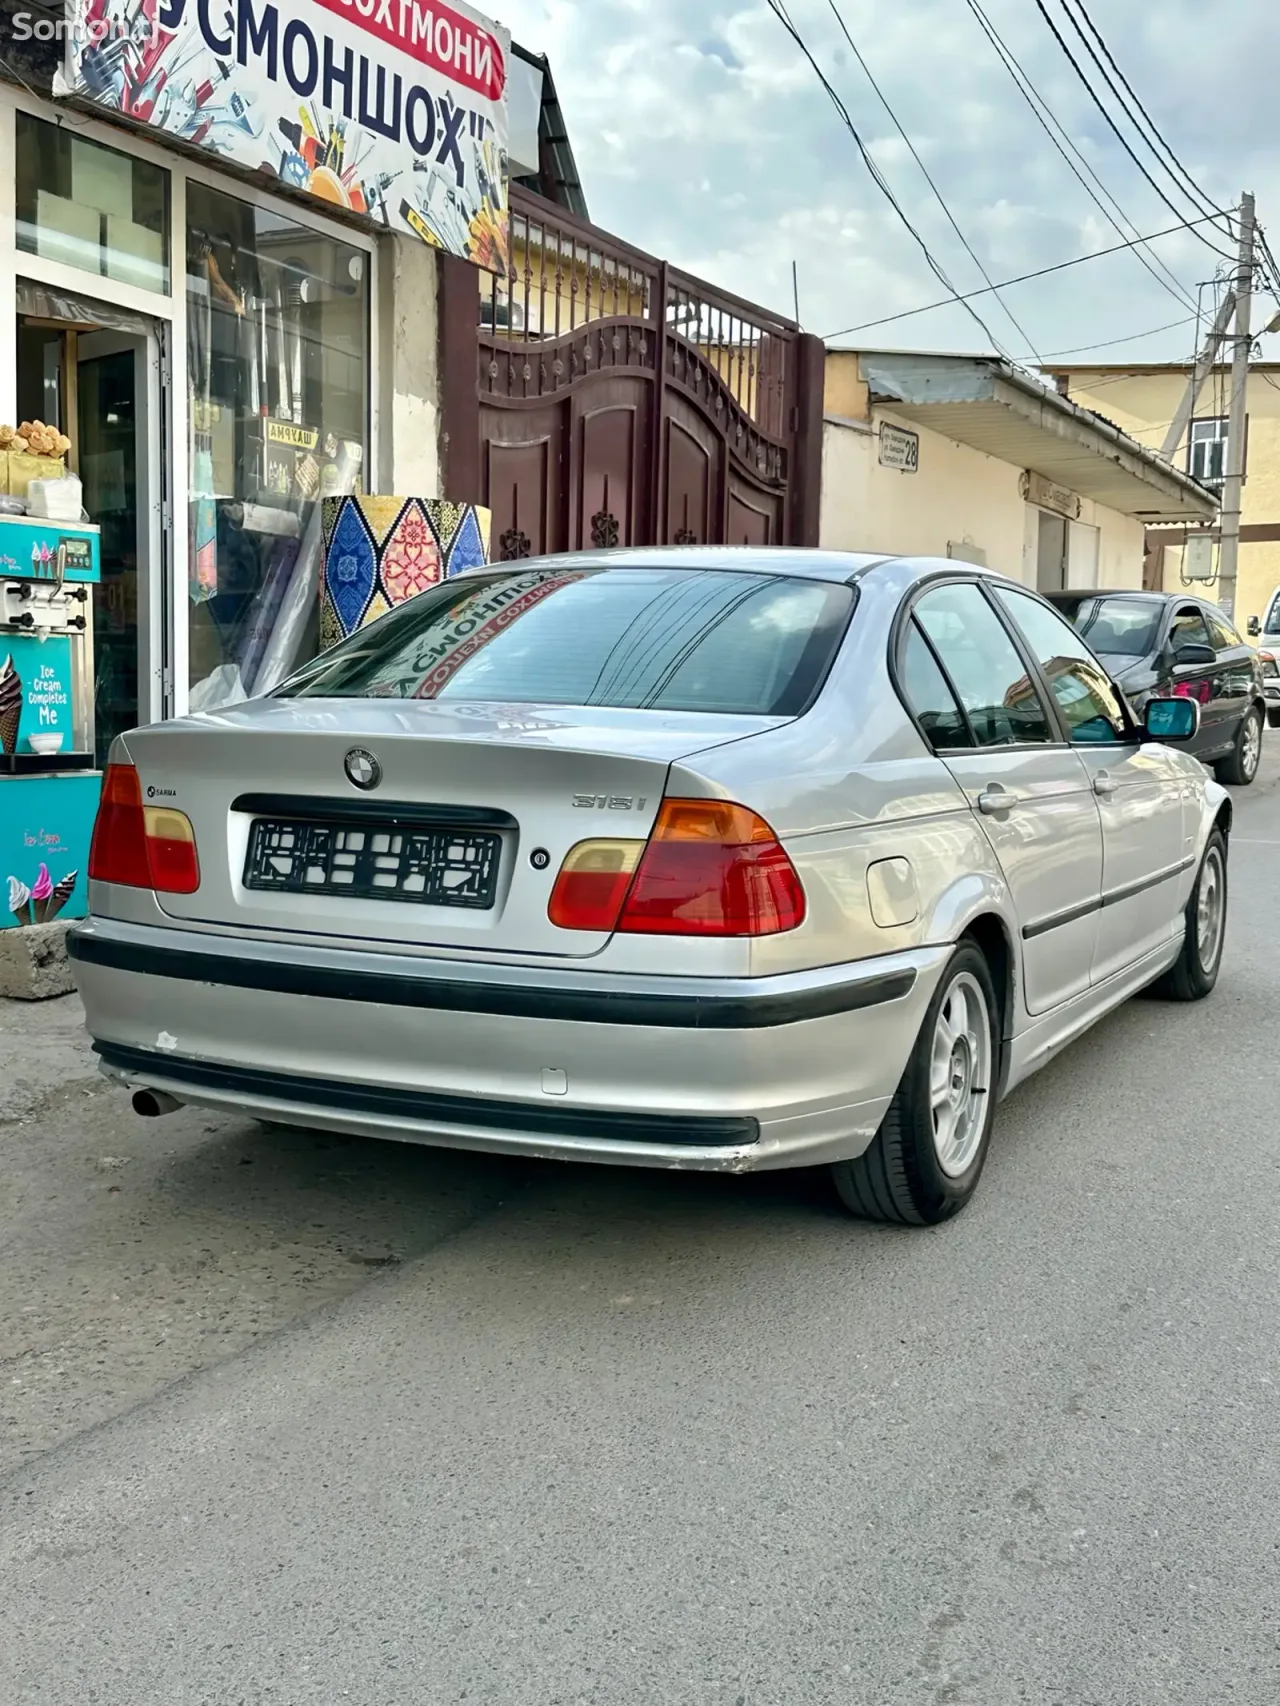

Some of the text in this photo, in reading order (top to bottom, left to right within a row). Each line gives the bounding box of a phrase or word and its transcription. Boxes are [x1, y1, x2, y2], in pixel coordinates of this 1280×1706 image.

[905, 440, 916, 467] 28
[40, 664, 55, 679] Ice
[33, 678, 62, 692] Cream
[28, 692, 68, 705] Completes
[39, 705, 58, 726] Me
[346, 750, 376, 765] BMW
